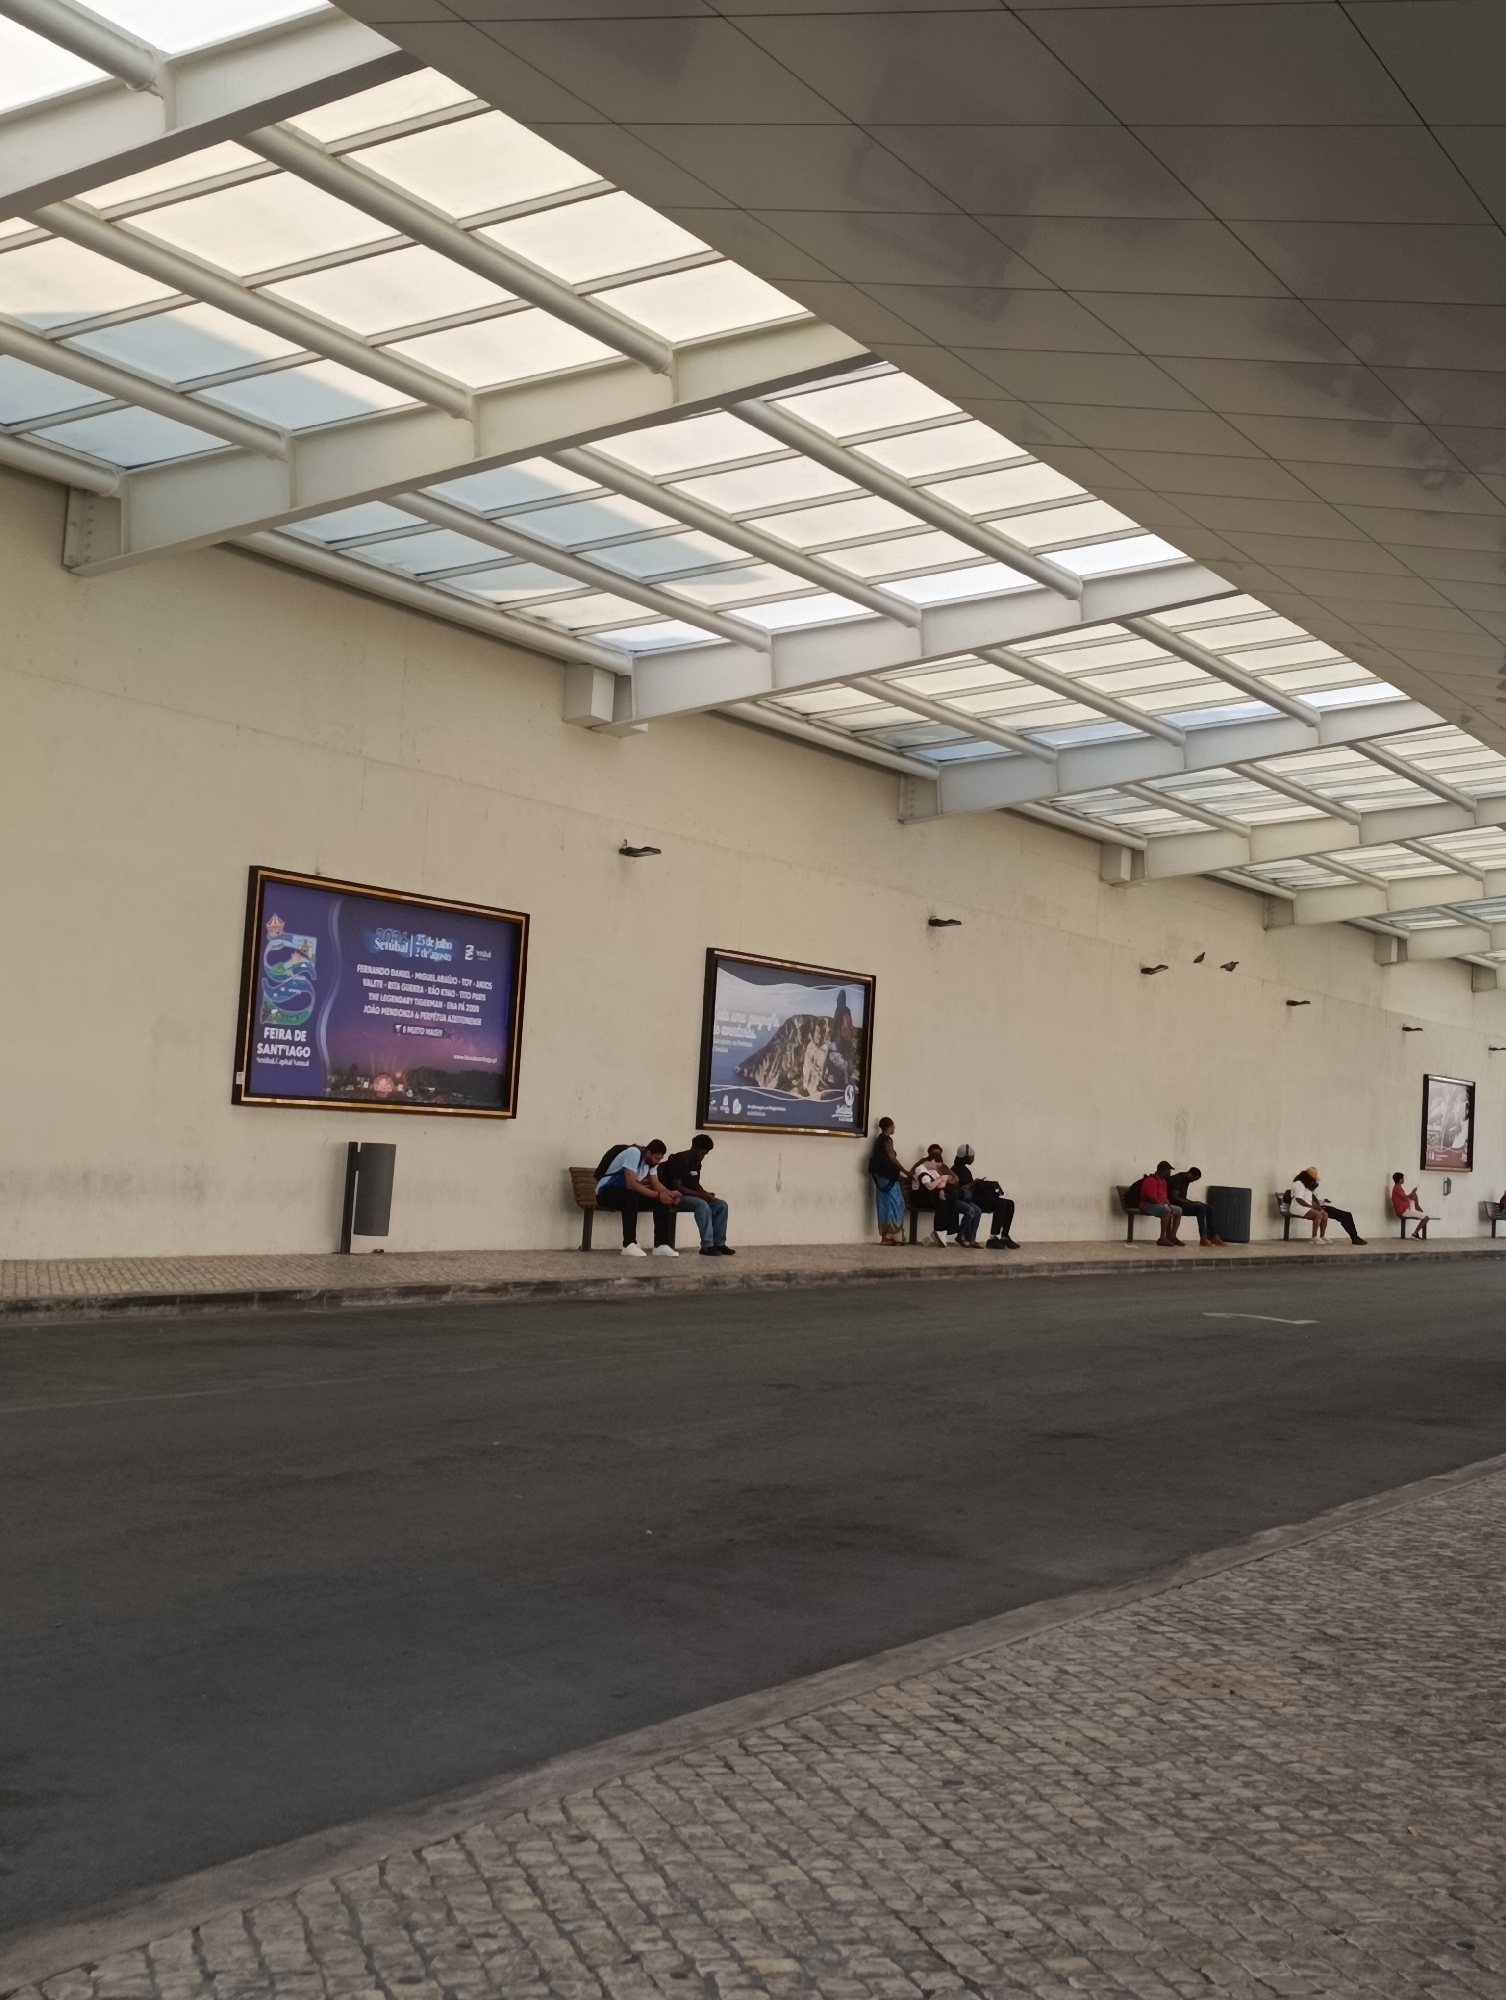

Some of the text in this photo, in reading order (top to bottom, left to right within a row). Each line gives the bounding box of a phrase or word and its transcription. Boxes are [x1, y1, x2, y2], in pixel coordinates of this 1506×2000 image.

[375, 938, 408, 953] Setúbal
[425, 936, 434, 947] de
[435, 937, 452, 950] julho
[415, 947, 452, 962] 2 de agosto
[357, 964, 390, 976] FERNANDO
[391, 968, 411, 979] DANIEL
[415, 972, 436, 982] MIGUEL
[368, 992, 380, 1001] THE
[380, 994, 413, 1005] LEGENDARY
[414, 998, 443, 1008] TIGERMAN
[363, 1003, 380, 1015] JOÃO
[264, 1027, 307, 1042] FEIRA DE
